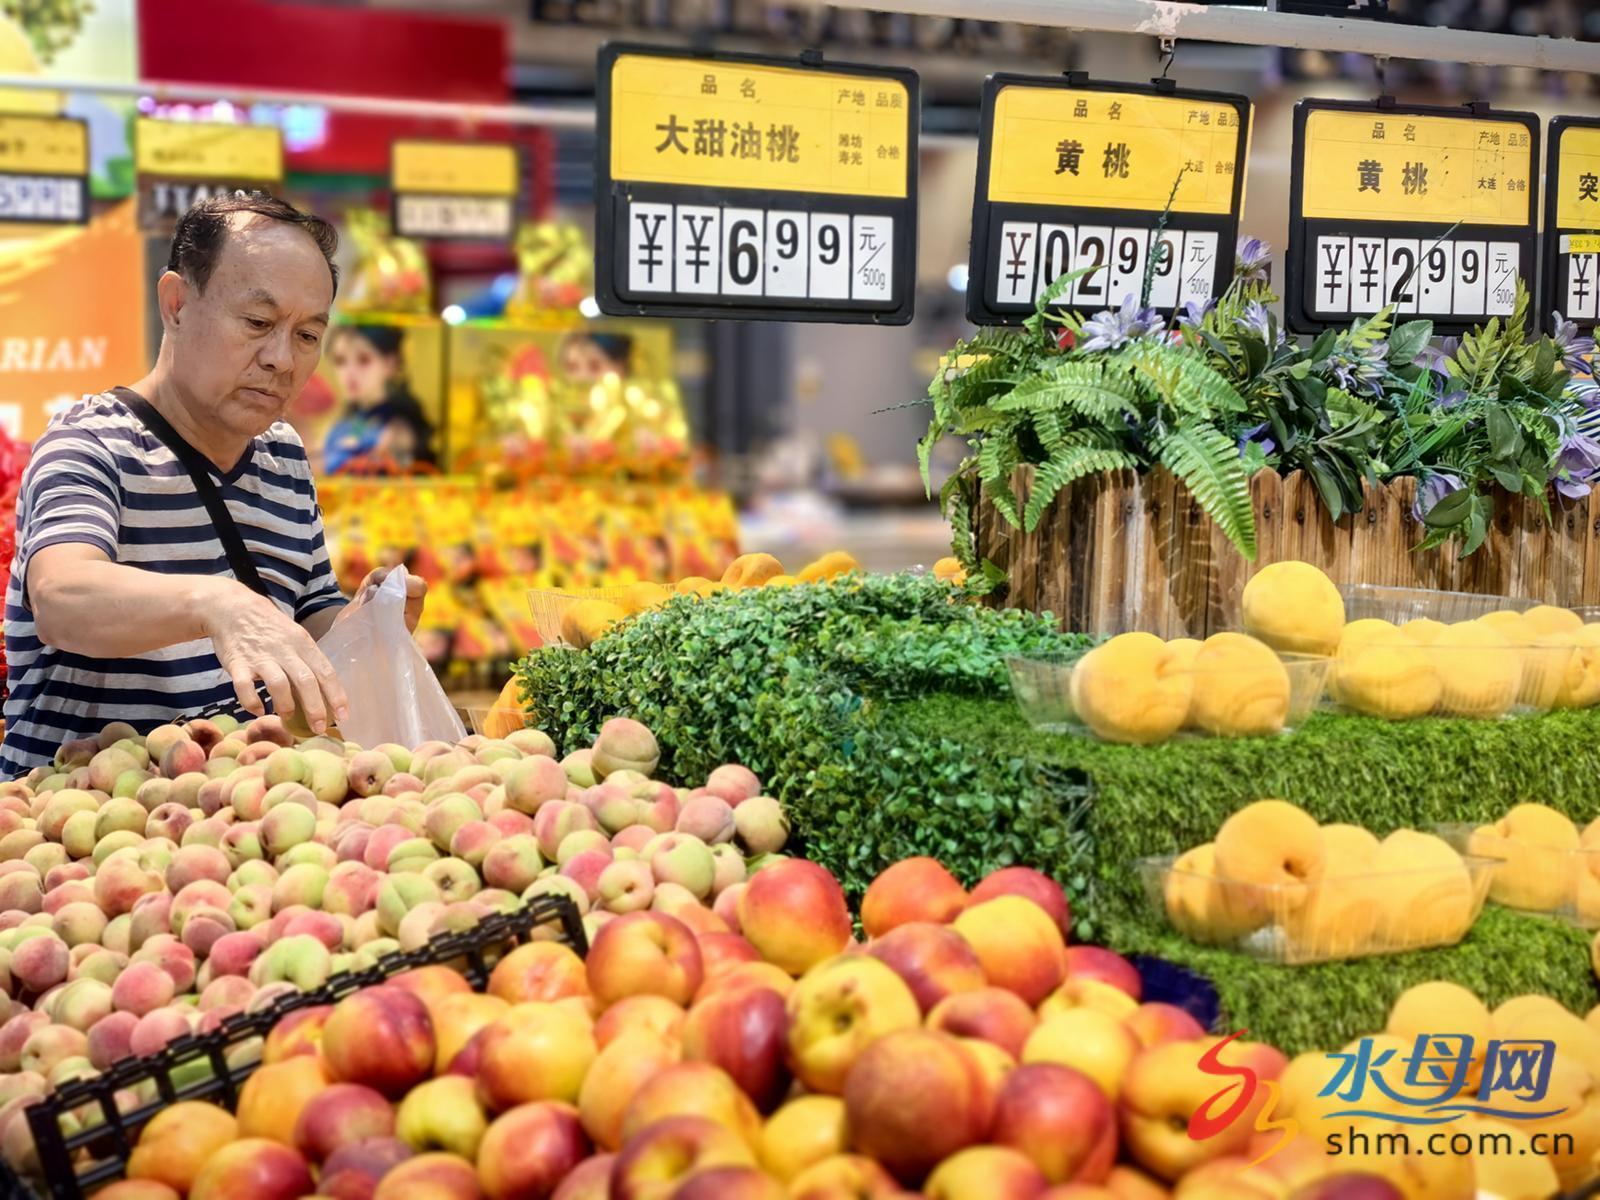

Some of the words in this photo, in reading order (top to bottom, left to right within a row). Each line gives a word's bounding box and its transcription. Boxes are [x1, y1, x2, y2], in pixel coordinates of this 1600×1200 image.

[700, 74, 757, 98] 品名
[837, 88, 866, 107] 产地
[875, 91, 903, 109] 品质
[1073, 99, 1122, 121] 品名
[1187, 110, 1210, 126] 产地
[655, 114, 800, 163] 大甜油桃
[1372, 121, 1417, 142] 品名
[1478, 130, 1501, 146] 产地
[1507, 132, 1529, 148] 品质
[876, 144, 900, 160] 合格
[1054, 139, 1131, 179] 黄桃
[1184, 159, 1205, 173] 大连
[1215, 160, 1235, 175] 合格
[1356, 159, 1429, 196] 黄桃
[1477, 176, 1497, 190] 大连
[1506, 178, 1526, 192] 合格
[1578, 172, 1599, 202] 突
